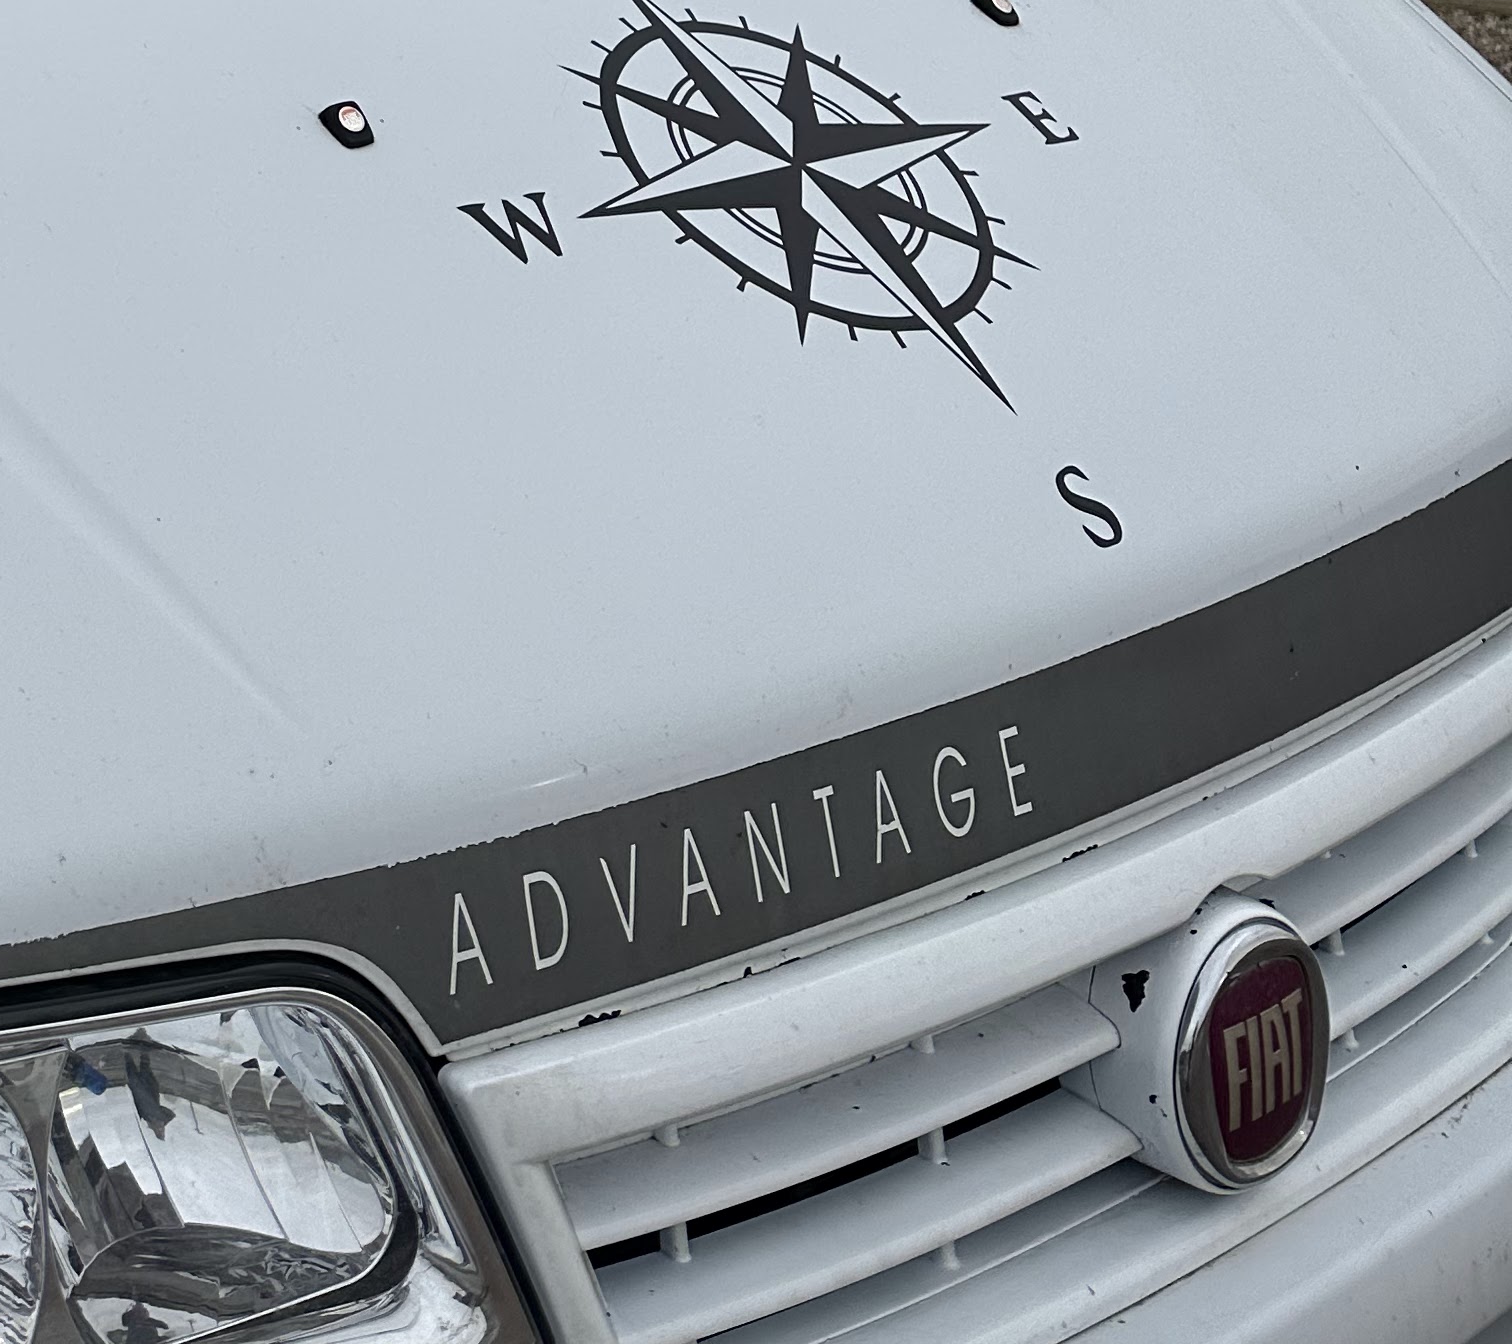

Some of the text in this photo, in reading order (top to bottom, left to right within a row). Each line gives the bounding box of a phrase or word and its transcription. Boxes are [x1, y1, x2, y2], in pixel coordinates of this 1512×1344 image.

[1000, 90, 1080, 146] E
[455, 192, 563, 264] W
[1054, 464, 1123, 549] S
[448, 724, 1035, 997] ADVANTAGE
[1222, 986, 1304, 1134] FIAT
